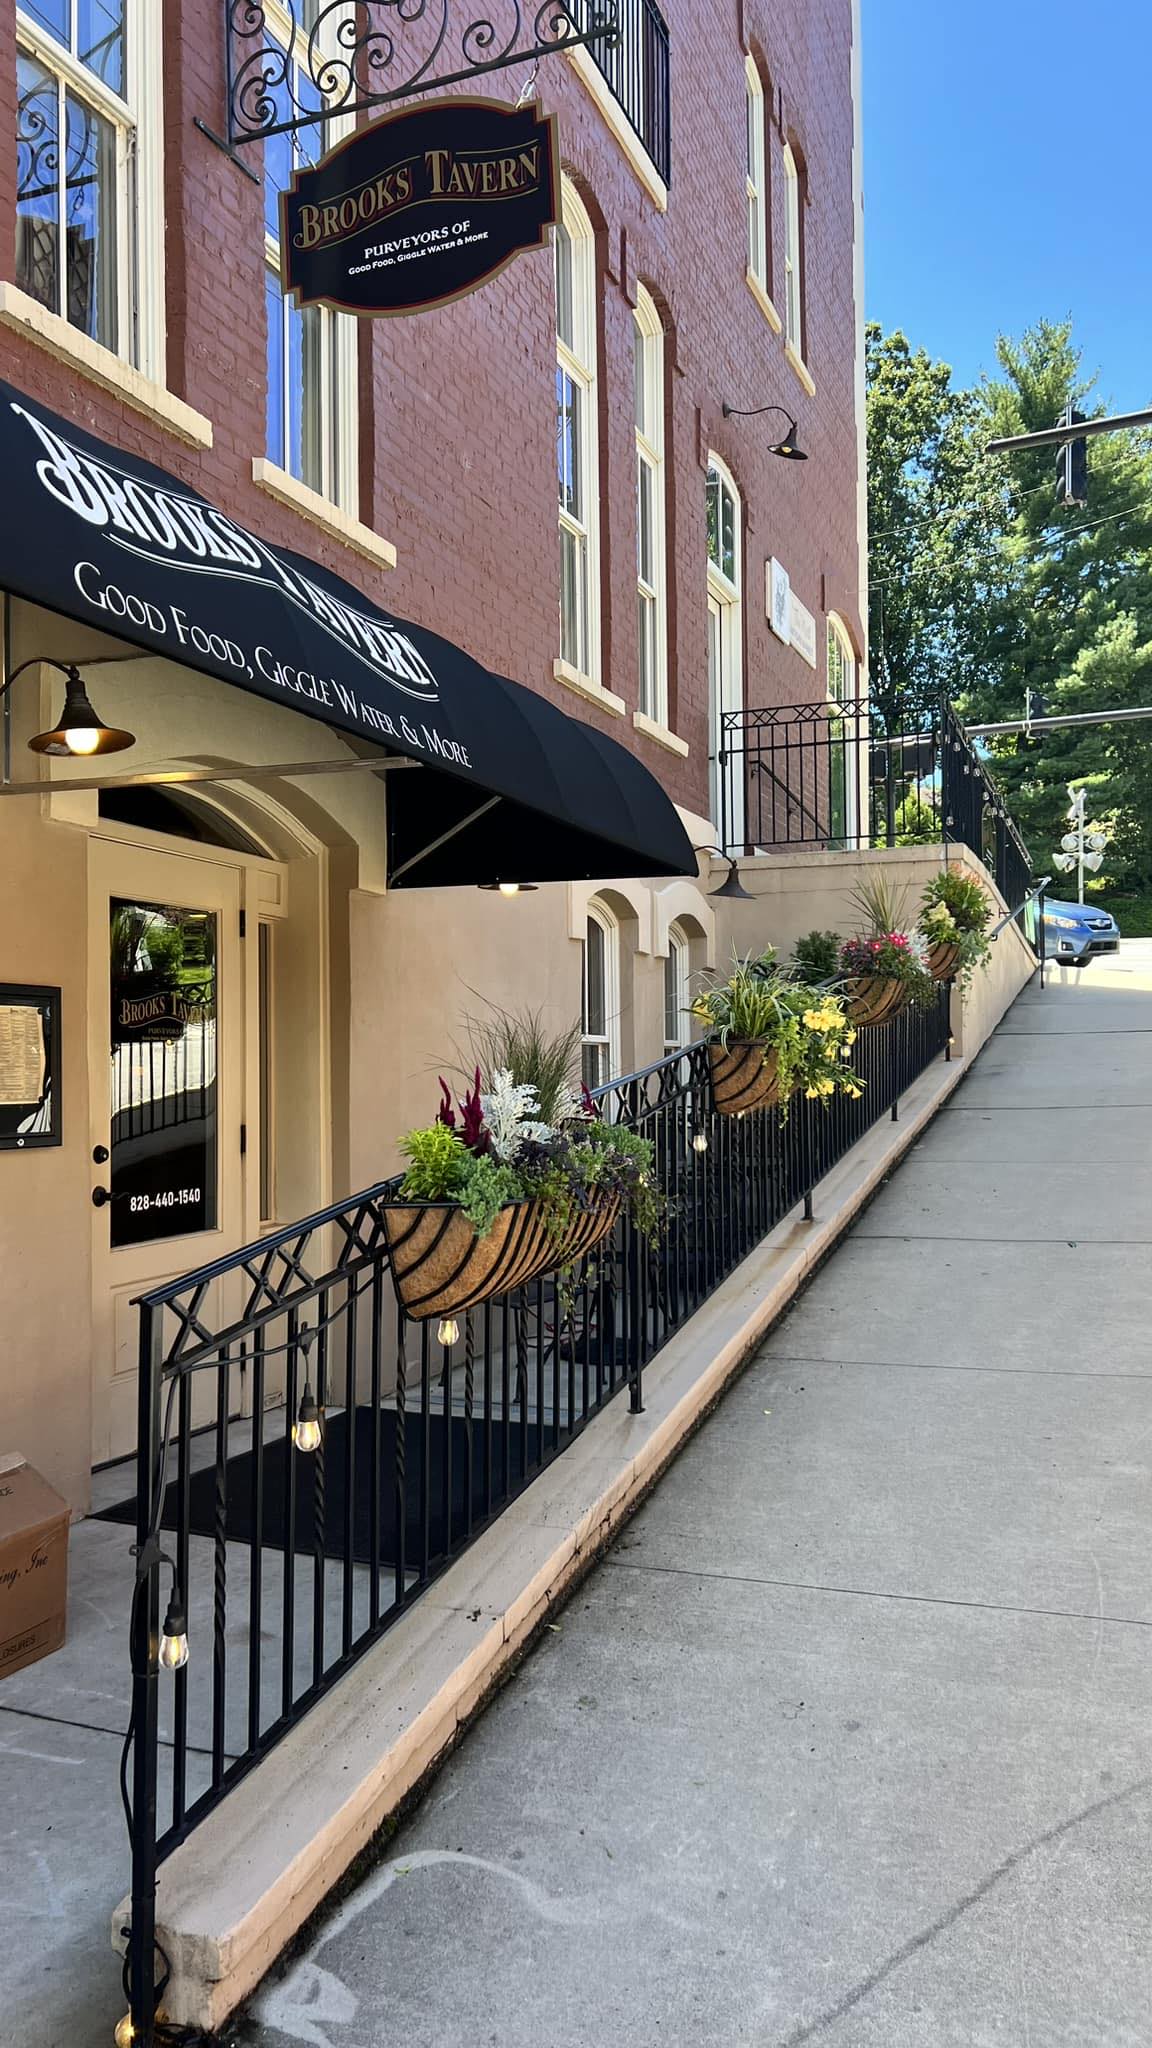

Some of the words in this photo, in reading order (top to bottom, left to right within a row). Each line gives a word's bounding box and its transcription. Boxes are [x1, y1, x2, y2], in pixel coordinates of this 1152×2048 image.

[293, 166, 412, 248] BROOKS
[425, 146, 539, 195] TAVERN
[348, 264, 371, 275] GOOD
[372, 257, 396, 269] FOOD,
[397, 249, 426, 262] GIGGLE
[427, 241, 456, 255] WATER
[456, 238, 463, 246] &
[464, 231, 489, 244] MORE
[364, 227, 449, 259] PURVEYORS
[452, 220, 471, 234] OF
[10, 403, 262, 569] BROOKS
[229, 518, 439, 688] TAVERN
[74, 561, 167, 634] GOOD
[169, 605, 254, 679] FOOD,
[255, 646, 333, 707] GIGGLE
[332, 679, 401, 738] WATER
[400, 715, 425, 749] &
[421, 724, 473, 769] MORE
[119, 998, 166, 1025] BROOKS
[130, 1188, 201, 1212] 828-440-1540
